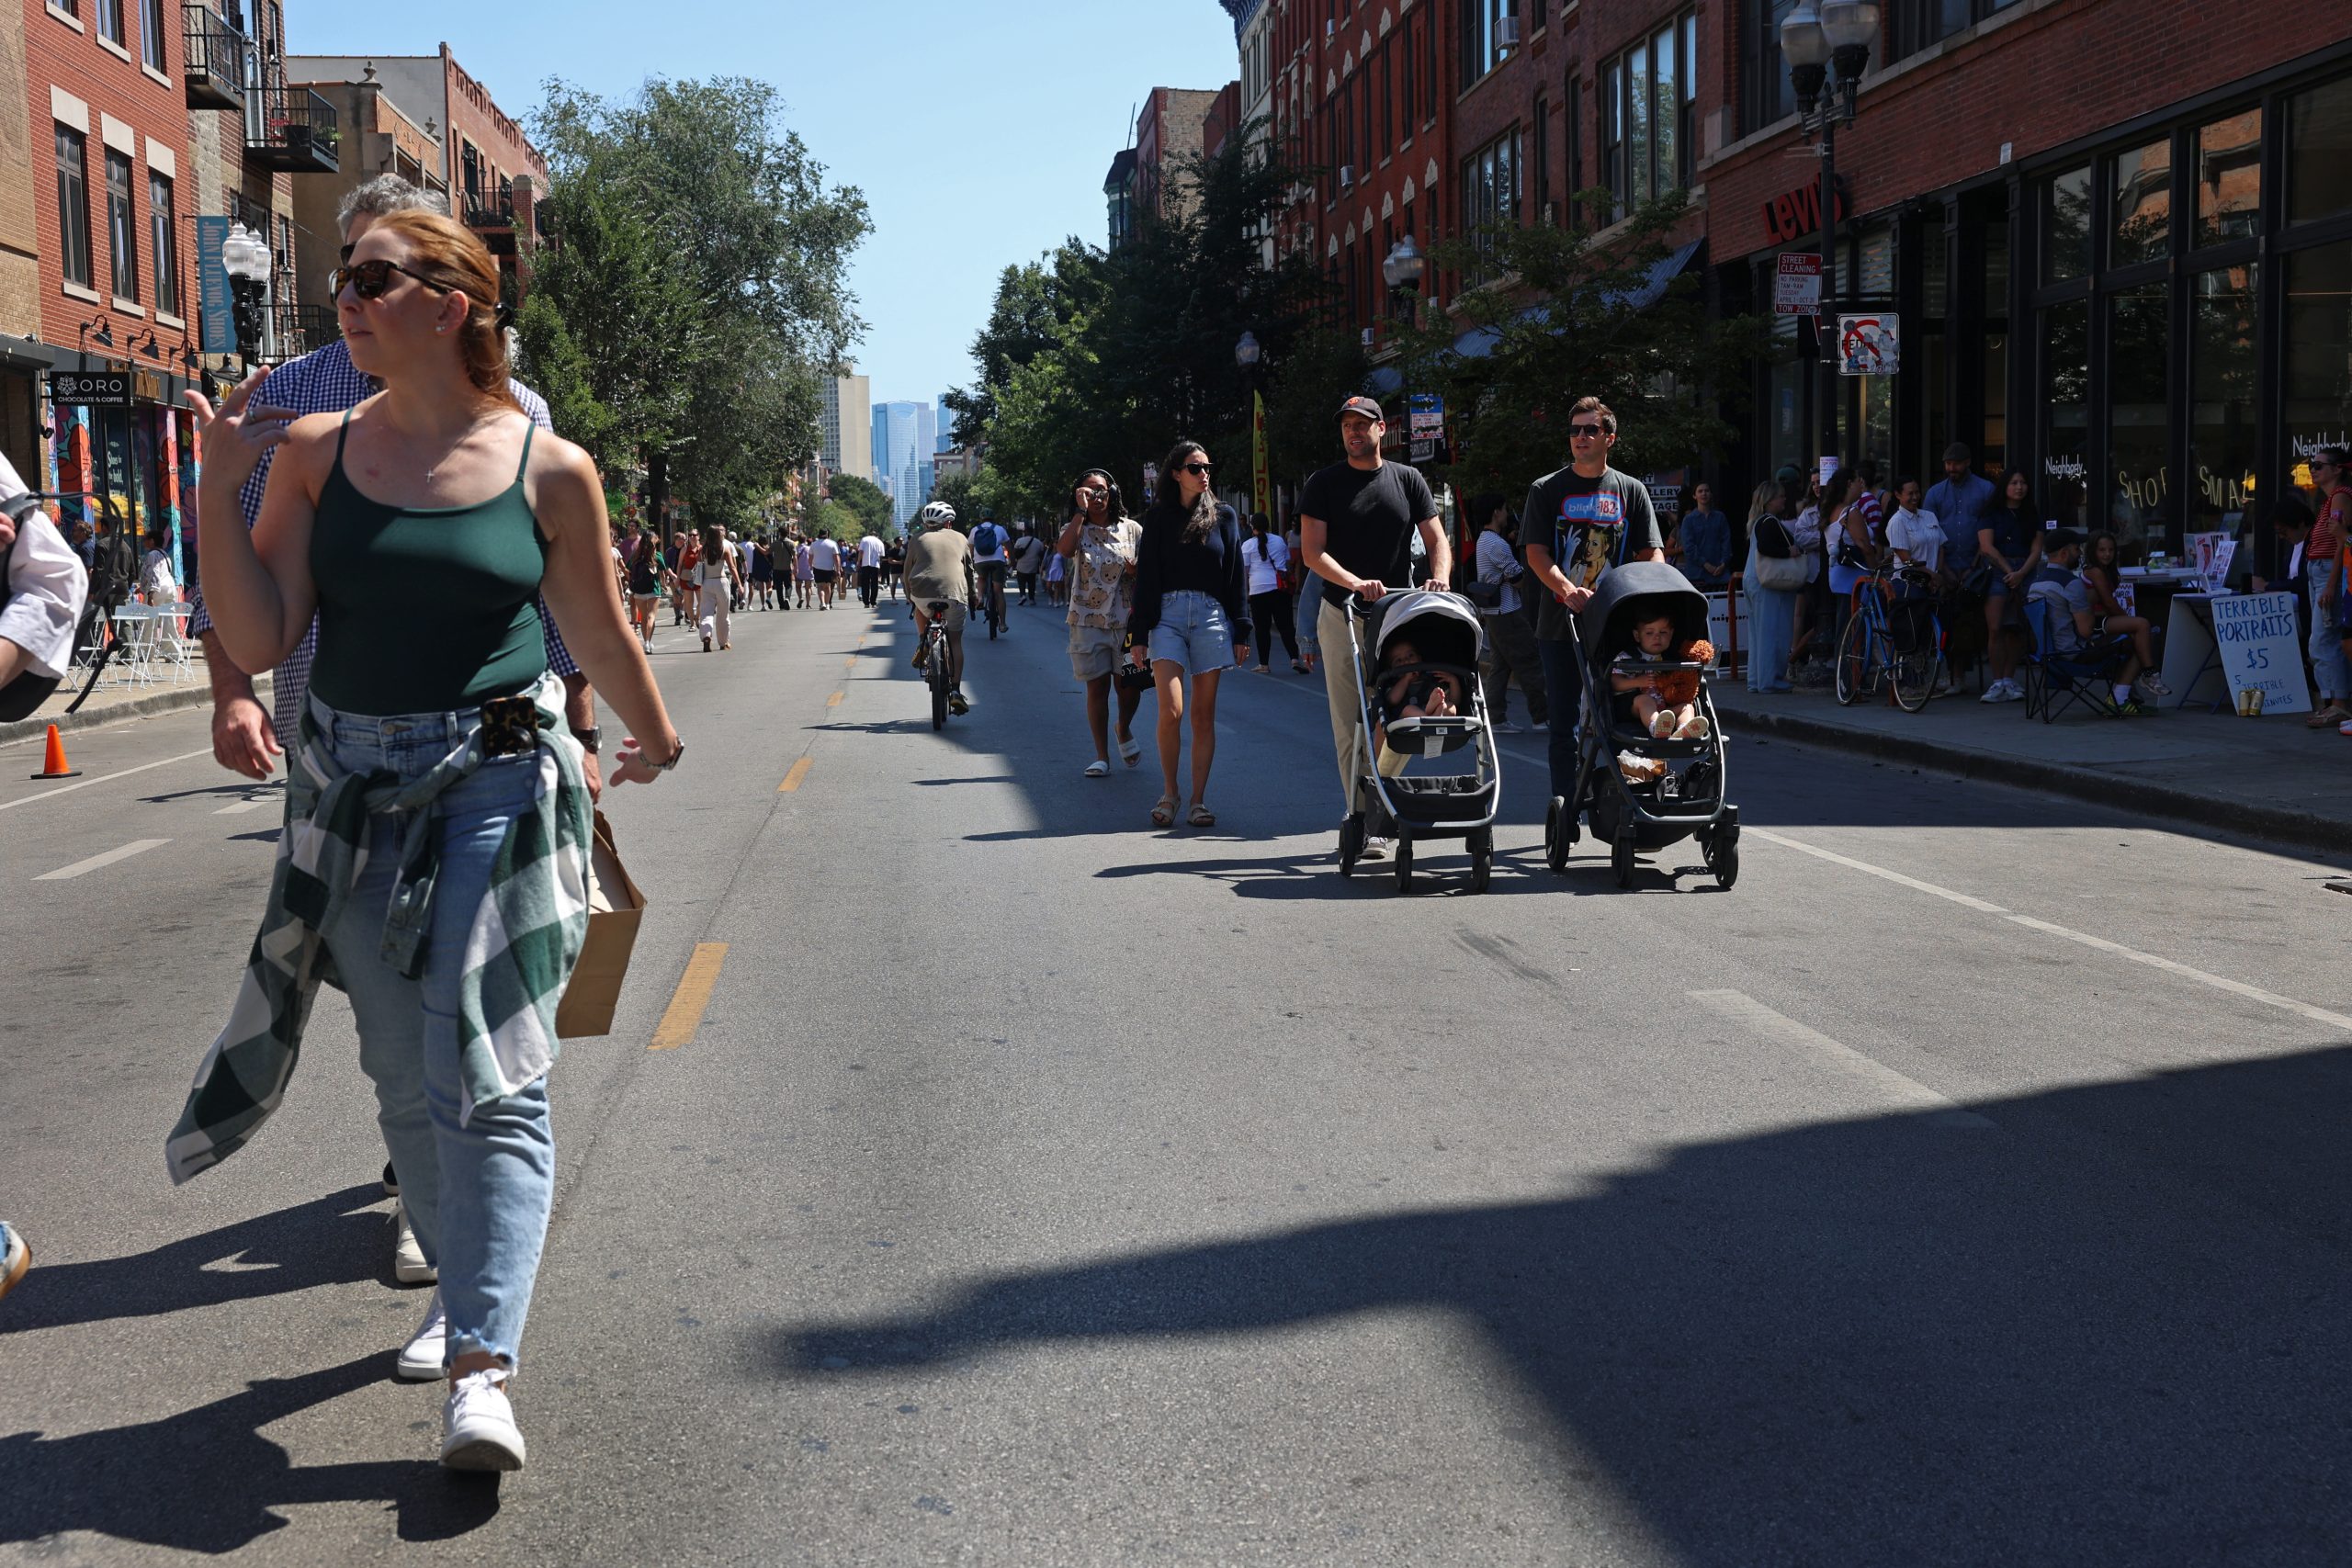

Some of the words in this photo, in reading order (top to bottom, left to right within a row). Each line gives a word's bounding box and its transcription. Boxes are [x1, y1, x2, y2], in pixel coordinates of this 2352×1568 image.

[1781, 255, 1807, 265] STREET
[1781, 264, 1816, 274] CLEANING
[1778, 304, 1794, 313] TOW
[1796, 304, 1810, 313] ZON
[80, 379, 123, 392] ORO
[2045, 454, 2083, 479] Neighborly
[1648, 488, 1680, 497] LLERY
[1568, 502, 1597, 513] blink
[1653, 502, 1679, 511] TAGE
[2214, 595, 2287, 619] TERRIBLE
[2216, 613, 2293, 643] PORTRAITS
[2246, 648, 2268, 670] $5
[2234, 674, 2242, 685] 5
[2241, 679, 2285, 691] TERRIBLE
